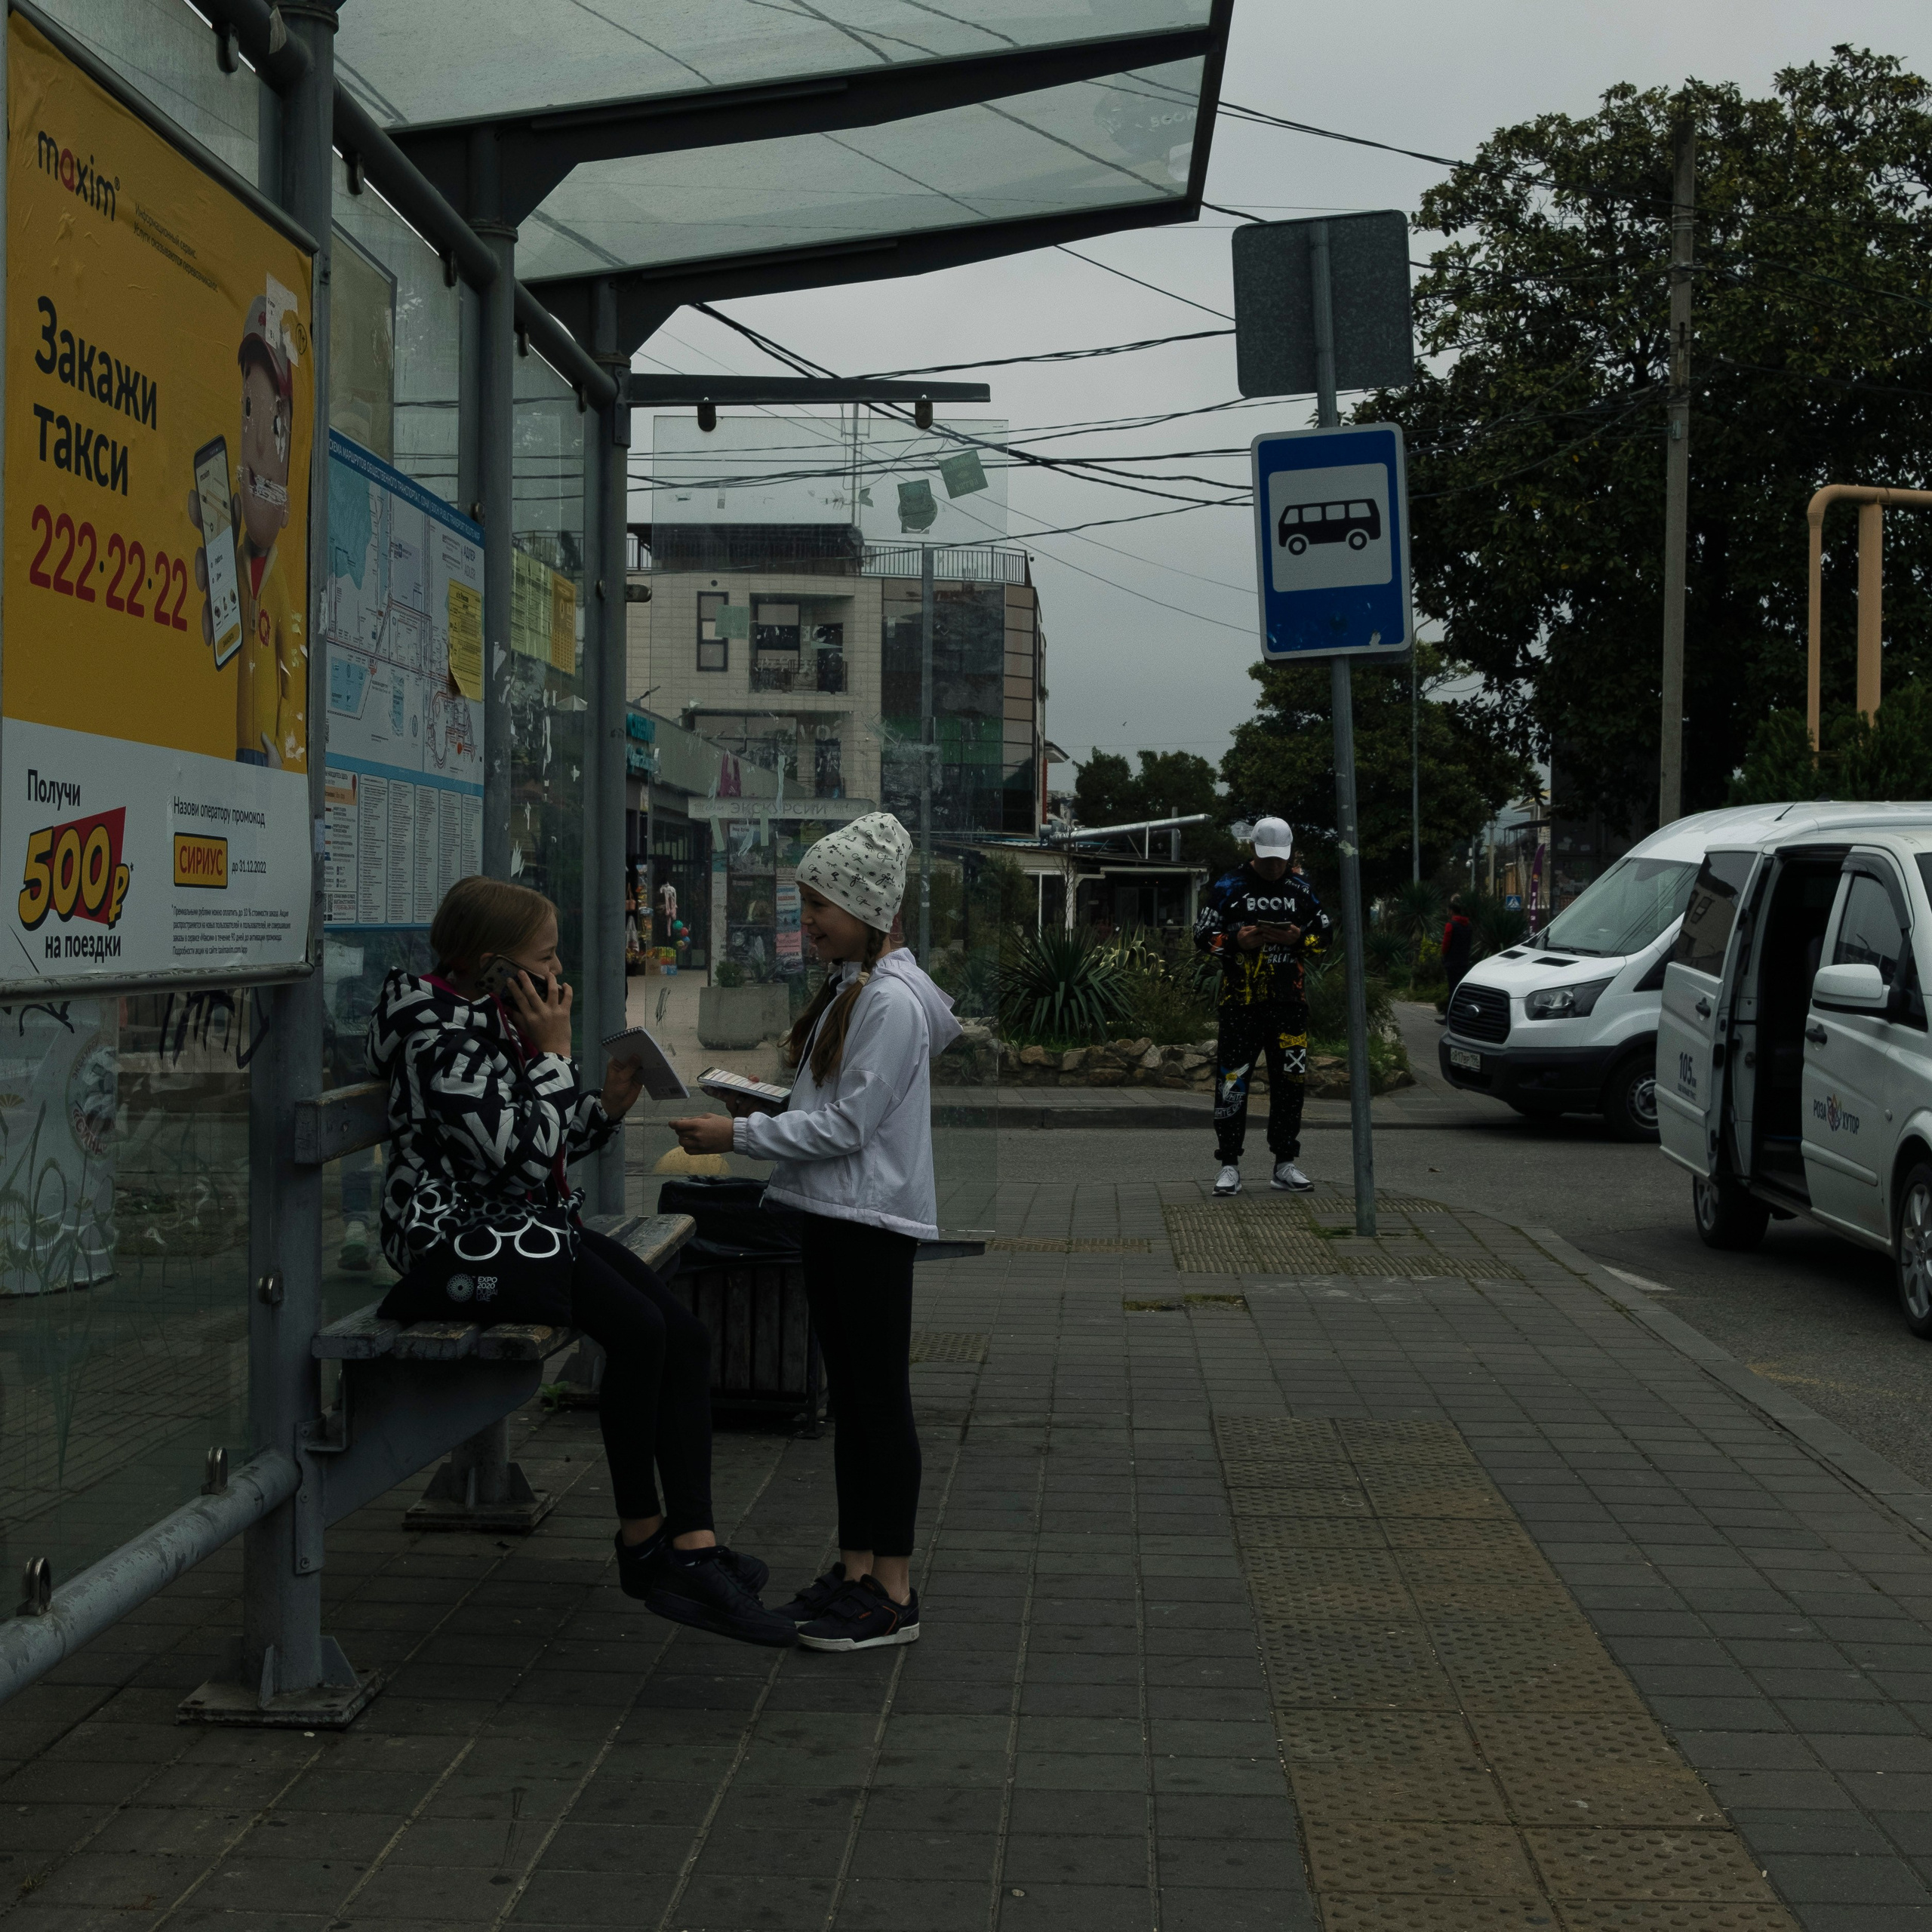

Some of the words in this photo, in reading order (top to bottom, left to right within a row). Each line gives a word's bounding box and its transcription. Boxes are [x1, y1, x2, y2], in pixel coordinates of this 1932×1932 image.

[38, 131, 116, 221] maxim
[35, 295, 157, 431] Закажи
[33, 403, 128, 497] такси
[27, 769, 81, 811] Получи
[174, 796, 198, 817] Назови
[200, 802, 230, 826] оператору
[232, 808, 266, 829] промокод
[179, 844, 223, 877] СИРИУС
[232, 861, 238, 874] до
[238, 859, 266, 874] 31.12.2022
[1247, 897, 1297, 912] BOOM
[45, 936, 61, 958] на
[65, 935, 121, 963] поездки
[1679, 1051, 1693, 1084] 105
[1814, 1099, 1827, 1121] РОЗА
[1841, 1111, 1860, 1135] ХУТОР
